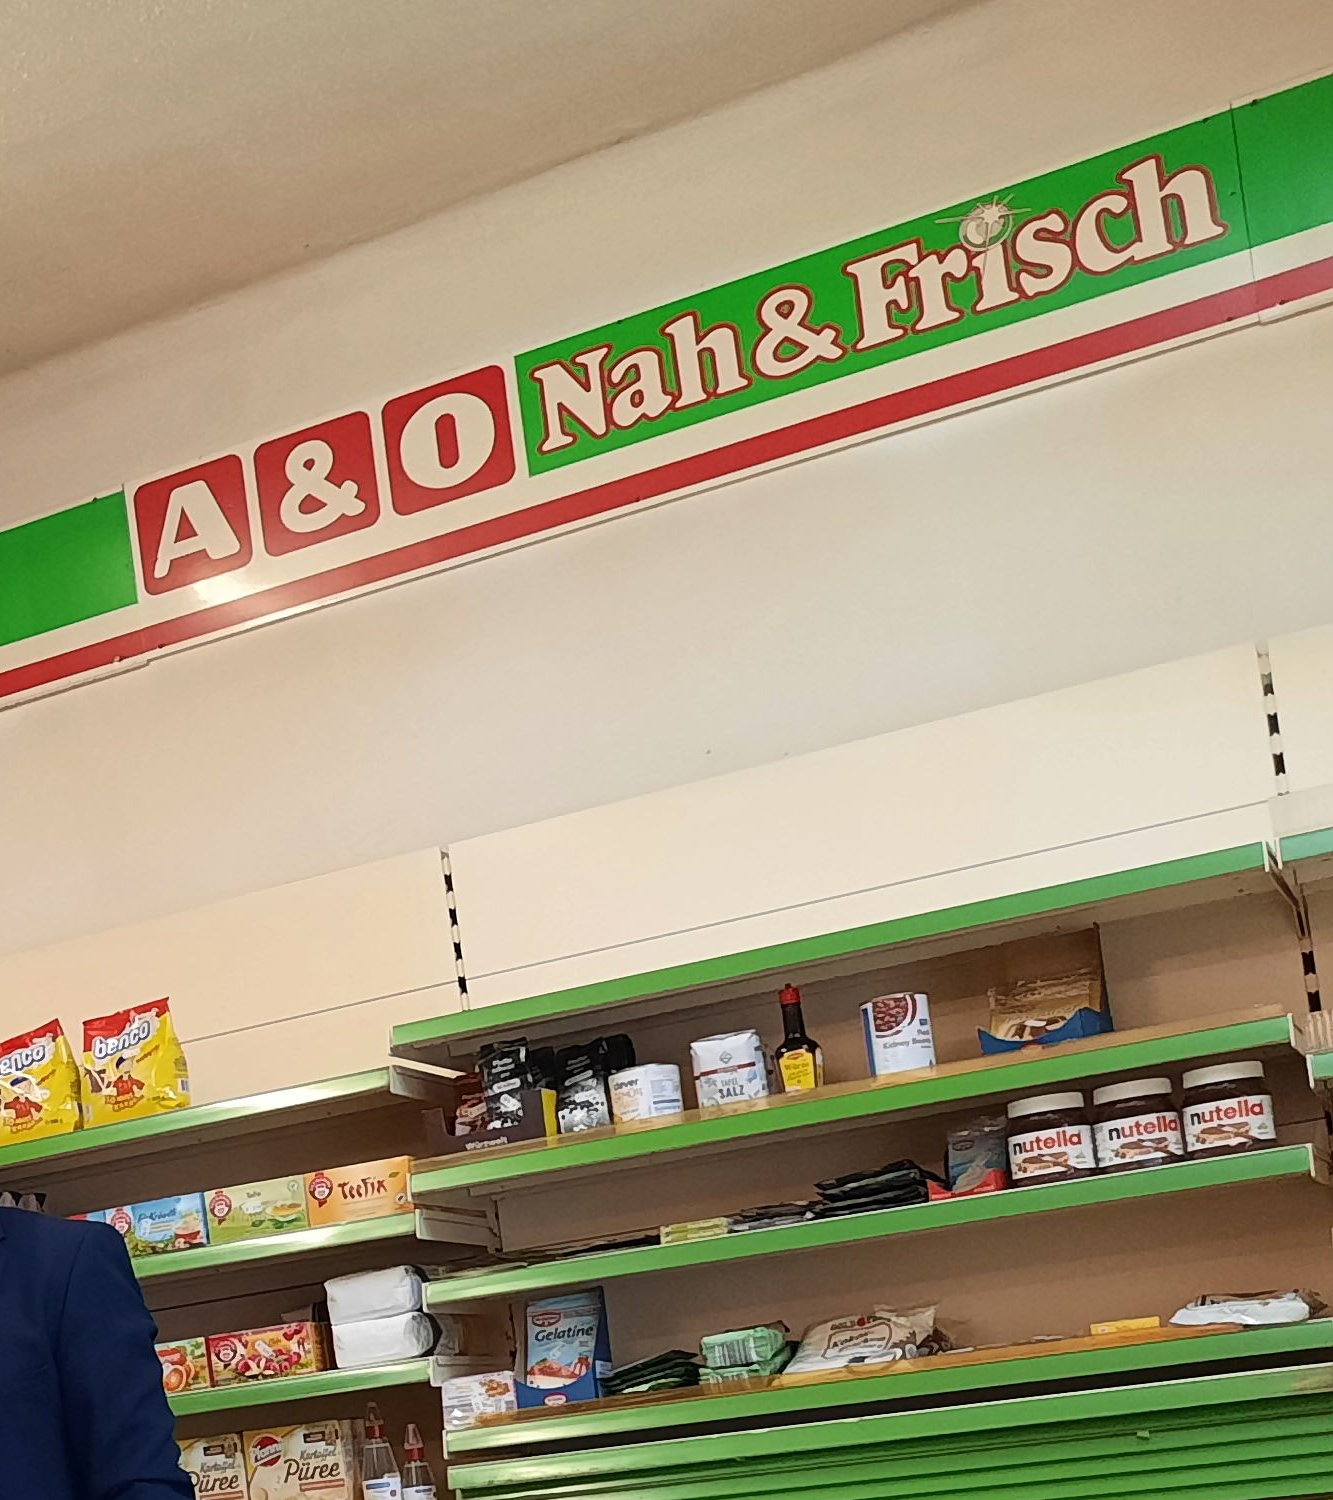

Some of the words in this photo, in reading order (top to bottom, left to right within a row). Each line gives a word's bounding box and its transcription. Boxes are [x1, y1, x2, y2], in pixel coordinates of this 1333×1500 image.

[151, 478, 244, 580] A
[277, 436, 367, 536] &
[397, 390, 498, 491] O
[93, 1020, 152, 1059] benco
[718, 1085, 746, 1100] SALZ
[1190, 1099, 1265, 1127] nutella
[1107, 1115, 1179, 1142] nutella
[1012, 1129, 1083, 1156] nutella
[534, 1324, 595, 1342] Gelatine
[283, 1457, 341, 1484] Püree
